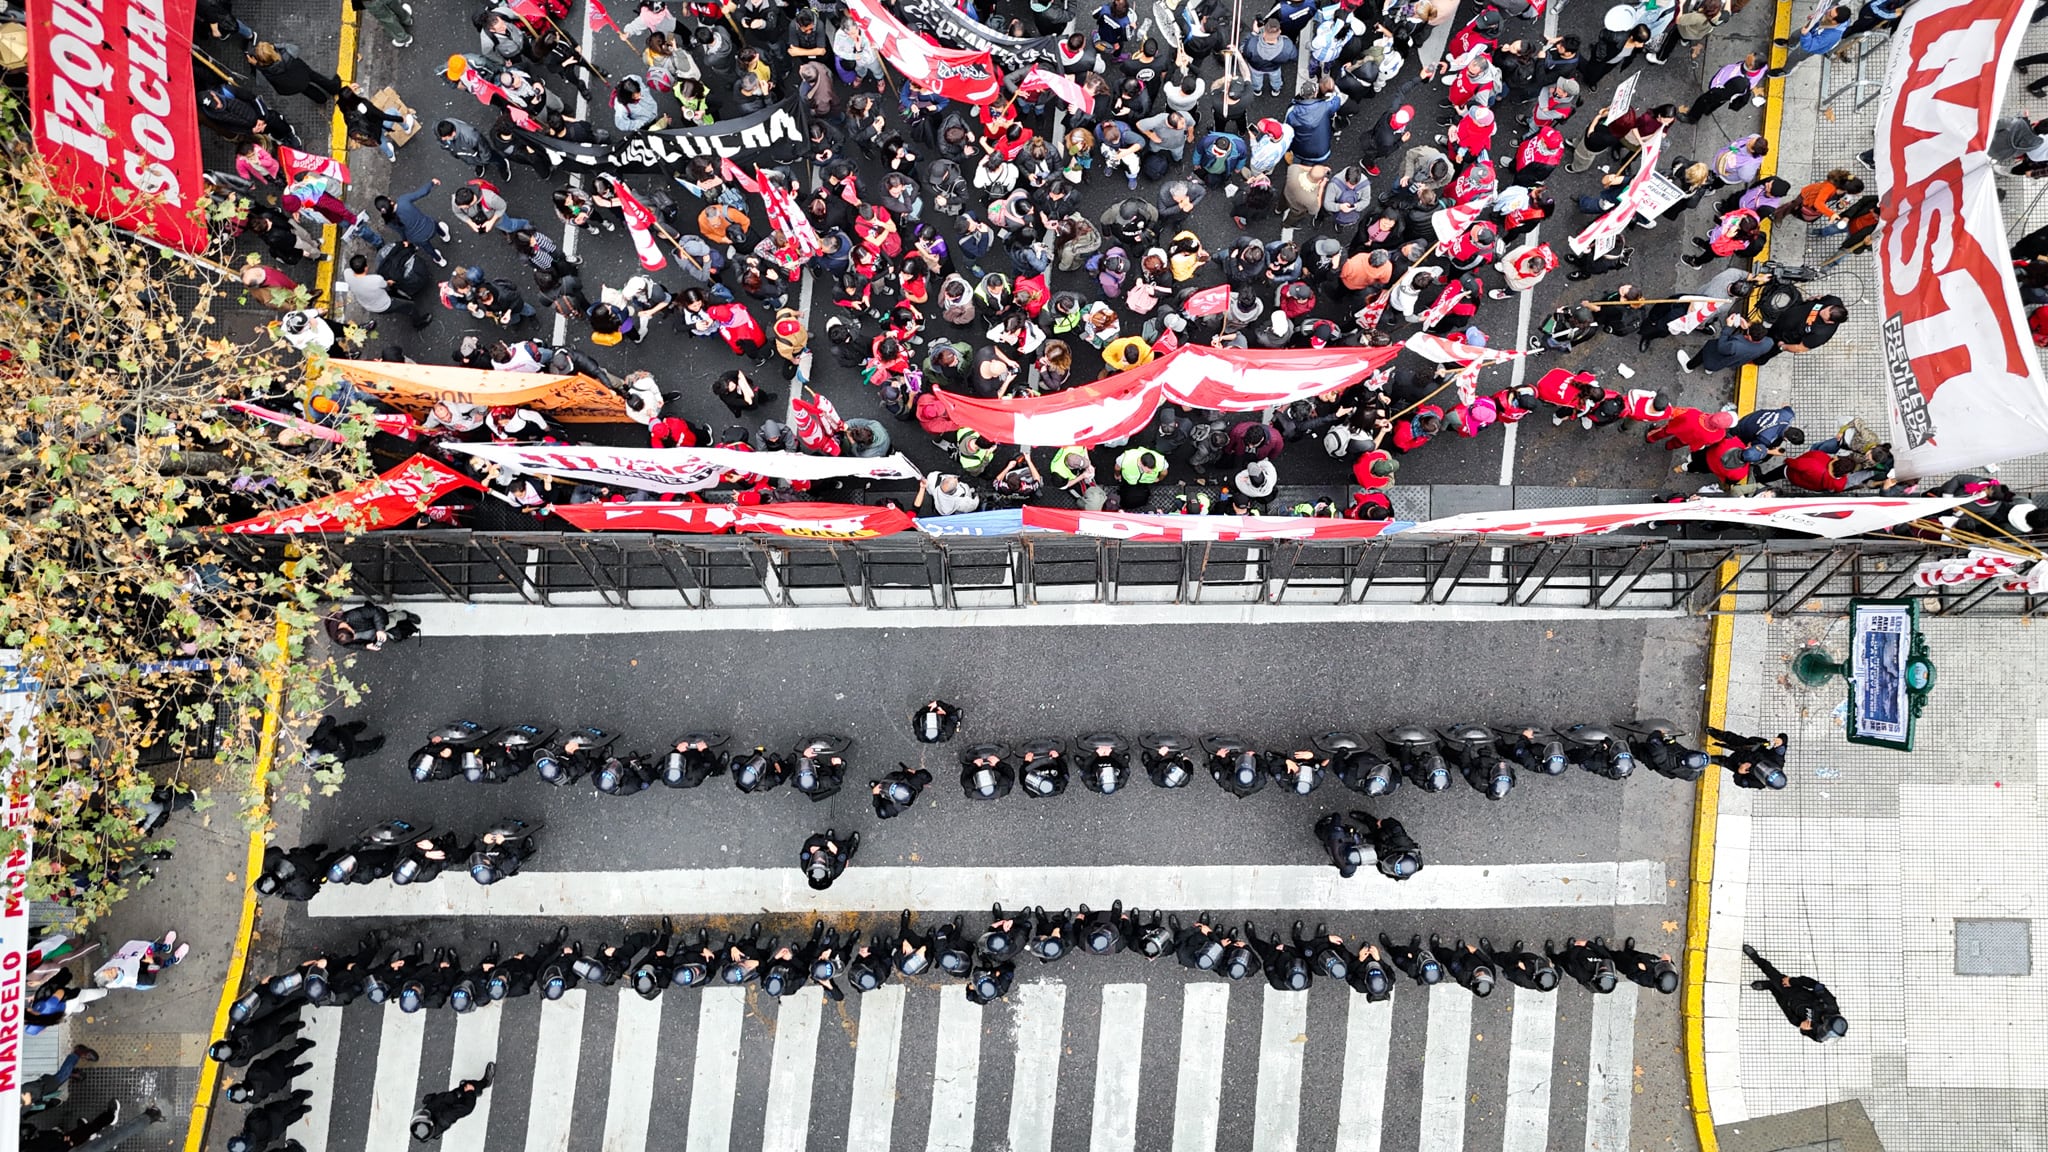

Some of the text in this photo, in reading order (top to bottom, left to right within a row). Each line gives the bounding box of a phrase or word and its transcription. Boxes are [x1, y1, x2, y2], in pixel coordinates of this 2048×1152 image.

[123, 0, 181, 208] SOCIA
[1886, 14, 2012, 382] MST
[1884, 321, 1923, 445] IZQUIERDA
[1891, 315, 1925, 410] FRENTE
[1914, 409, 1929, 434] DE
[0, 950, 22, 1093] MARCELO
